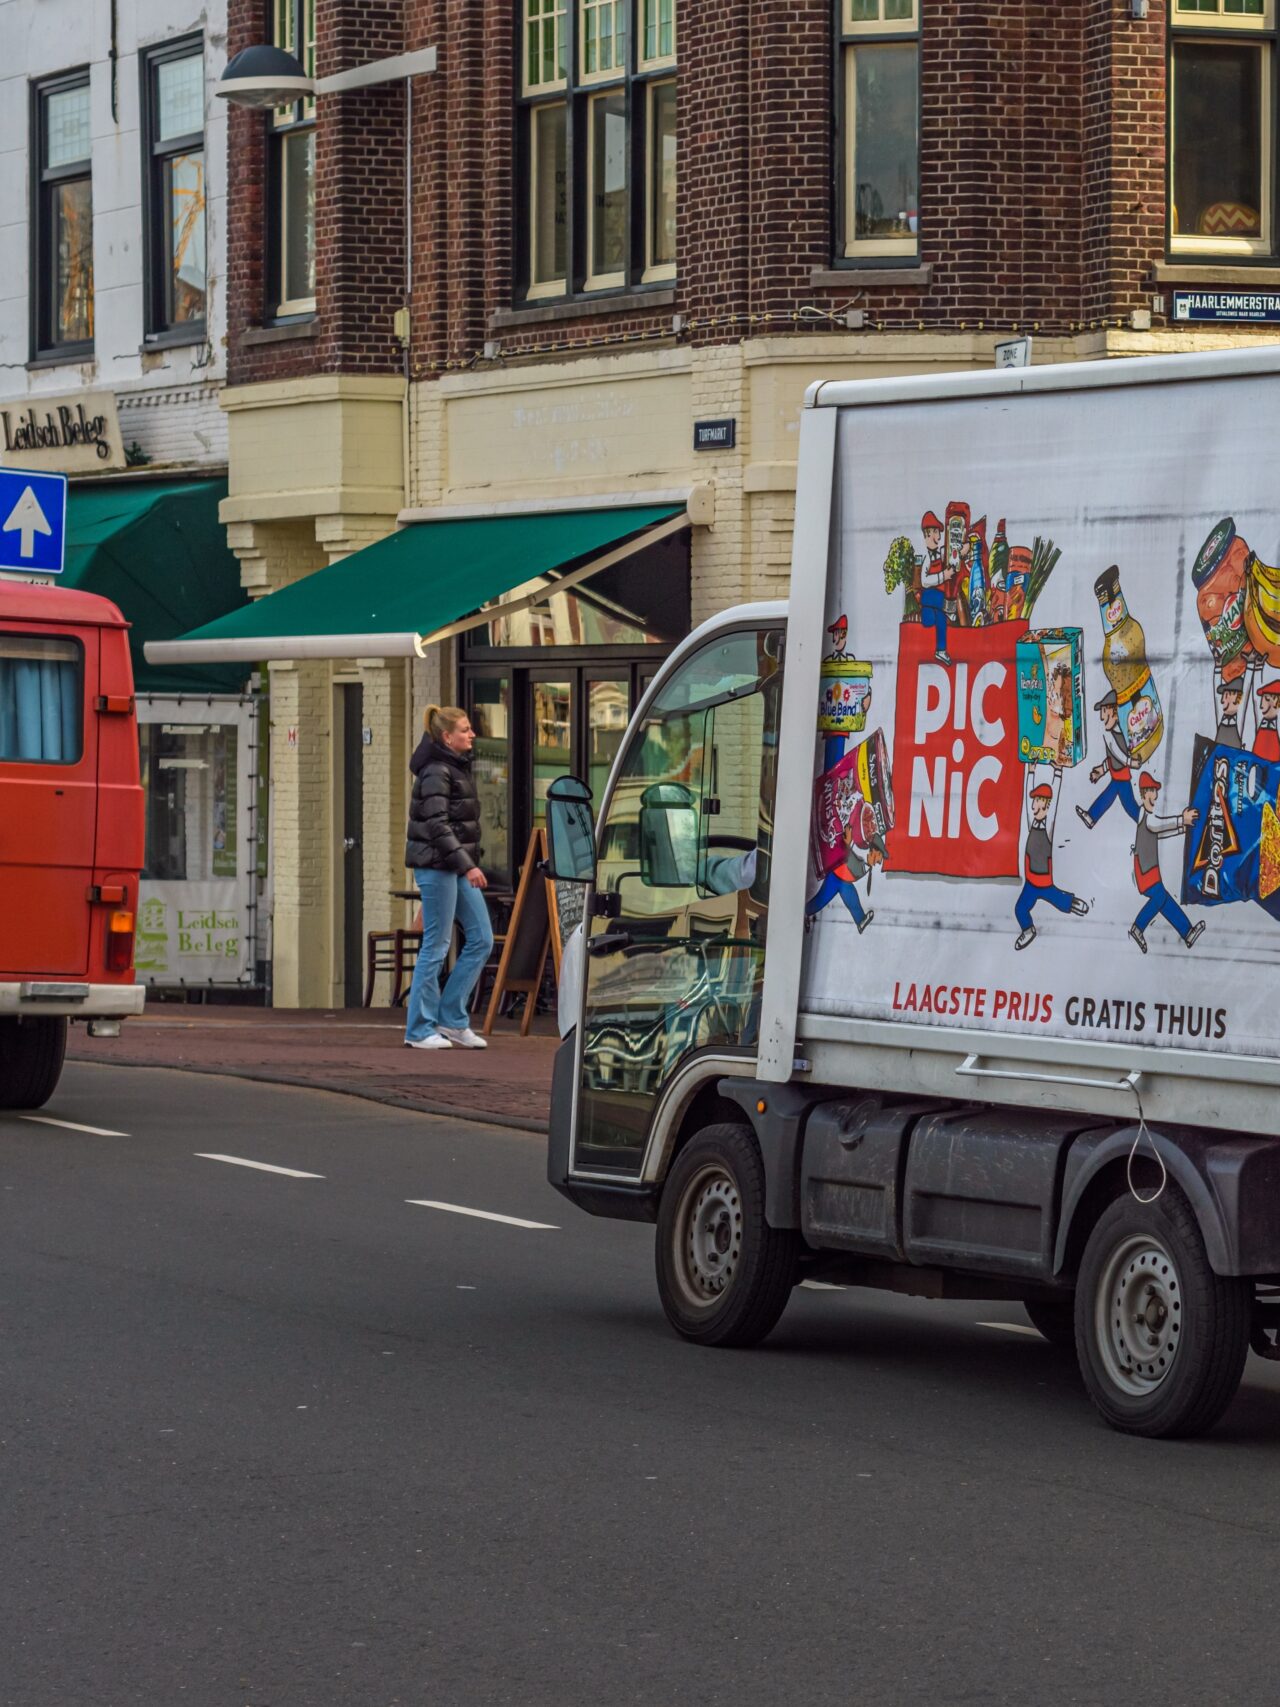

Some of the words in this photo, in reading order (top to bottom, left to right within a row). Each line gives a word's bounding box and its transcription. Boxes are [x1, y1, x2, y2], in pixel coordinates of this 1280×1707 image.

[1003, 348, 1018, 361] ZONE
[1, 410, 59, 451] Leidsch
[56, 402, 108, 459] Beleg
[699, 426, 727, 442] TURFMARKT
[820, 701, 837, 716] Blue
[837, 702, 857, 716] Band
[1130, 701, 1149, 727] Calvé
[177, 910, 239, 930] Leidsch
[178, 933, 239, 957] Beleg
[892, 982, 987, 1017] LAAGSTE
[992, 990, 1054, 1023] PRIJS
[1065, 996, 1146, 1032] GRATIS
[1154, 1003, 1227, 1039] THUIS
